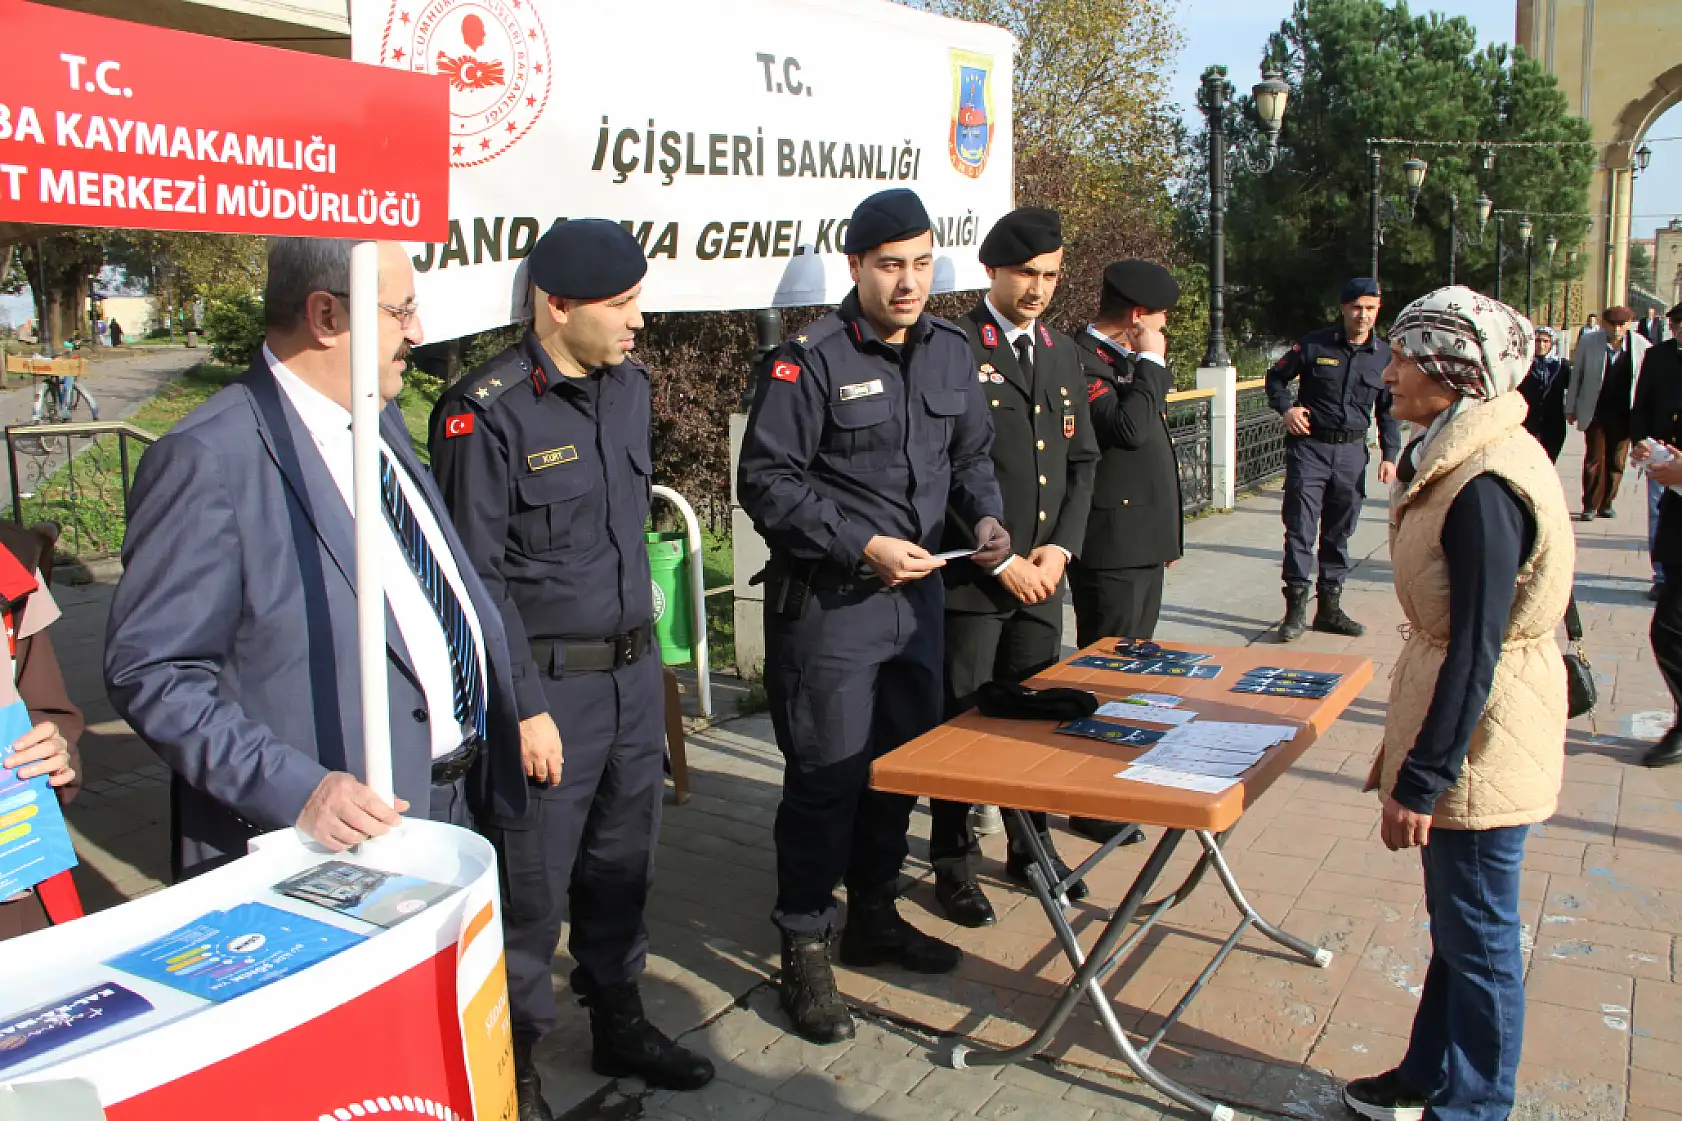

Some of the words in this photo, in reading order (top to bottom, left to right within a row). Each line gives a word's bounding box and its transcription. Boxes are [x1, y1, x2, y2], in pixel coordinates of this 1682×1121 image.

[60, 53, 133, 99] T.C.
[756, 51, 812, 97] T.C.
[55, 110, 337, 174] KAYMAKAMLIĞI
[591, 115, 764, 186] İÇİŞLERİ
[776, 138, 921, 181] BAKANLIĞI
[40, 167, 207, 214] MERKEZİ
[216, 179, 421, 228] MÜDÜRLÜĞÜ
[695, 220, 805, 260] GENEL
